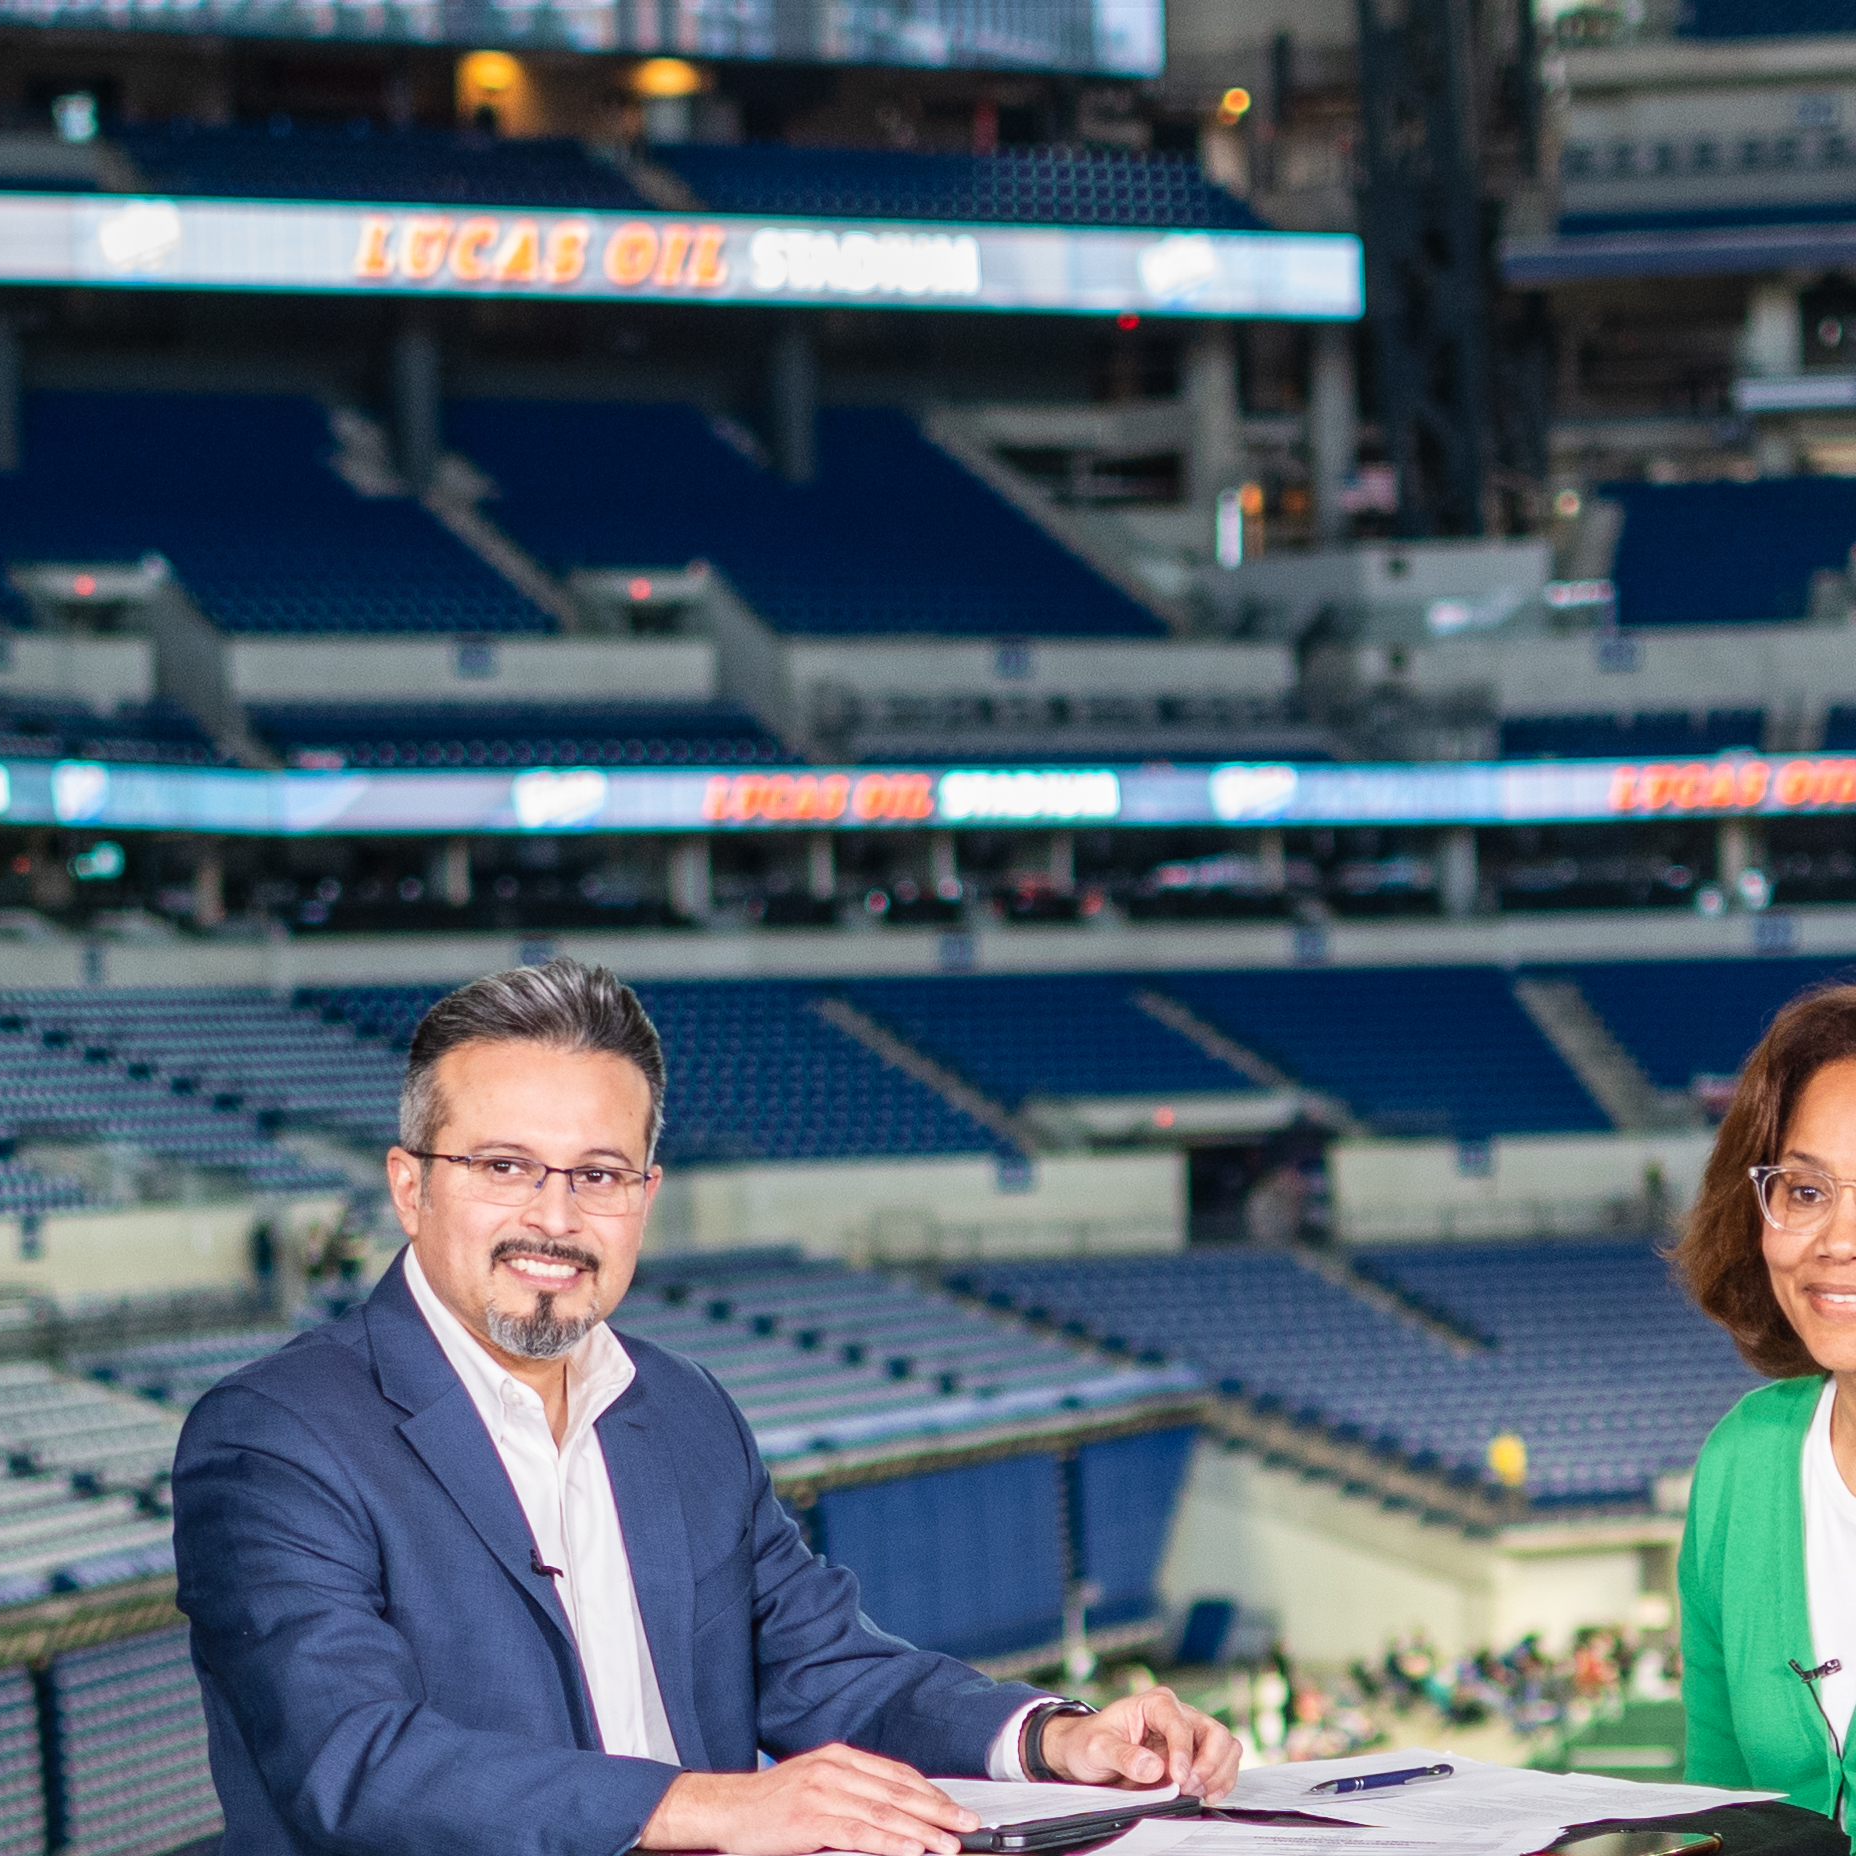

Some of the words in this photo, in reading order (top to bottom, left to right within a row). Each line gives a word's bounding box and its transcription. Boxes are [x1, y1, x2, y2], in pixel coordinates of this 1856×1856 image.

[354, 215, 589, 282] LUCAS
[603, 220, 729, 290] OIL
[750, 226, 981, 295] STADIUM
[703, 774, 847, 821] LUCAS
[1608, 761, 1769, 812] LUCAS
